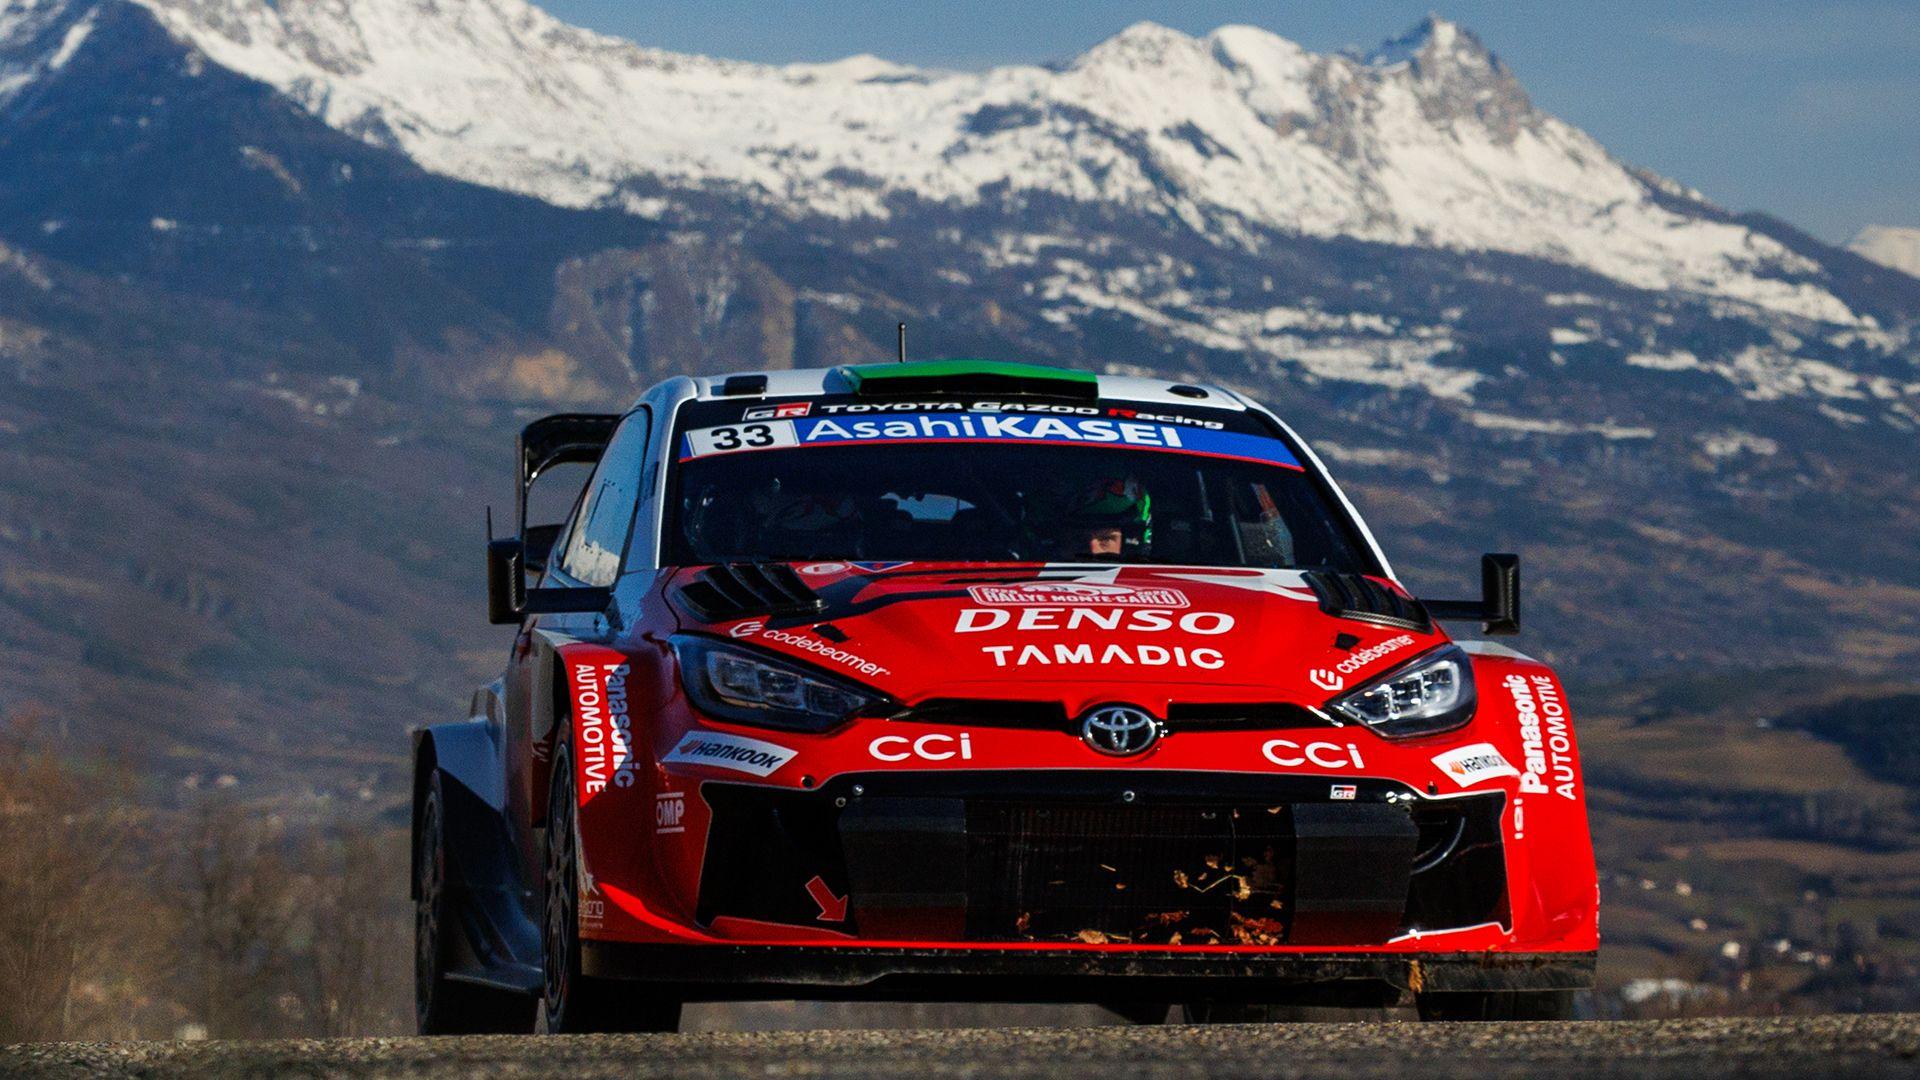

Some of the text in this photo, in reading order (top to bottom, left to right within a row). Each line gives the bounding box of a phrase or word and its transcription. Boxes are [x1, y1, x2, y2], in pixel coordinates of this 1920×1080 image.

[745, 401, 1225, 430] GR TOYOTA GAZOO Racing
[710, 424, 776, 450] 33
[984, 588, 1047, 603] RALLYE
[954, 607, 1235, 635] DENSO
[762, 628, 888, 678] codebeamer
[981, 643, 1226, 670] TAMADIC
[1336, 634, 1416, 674] codebeamer
[575, 663, 608, 794] AUTOMOTIVE
[603, 663, 641, 788] Panasonic
[1502, 674, 1549, 794] Panasonic
[1530, 674, 1577, 800] AUTOMOTIVE
[656, 800, 685, 826] OMP
